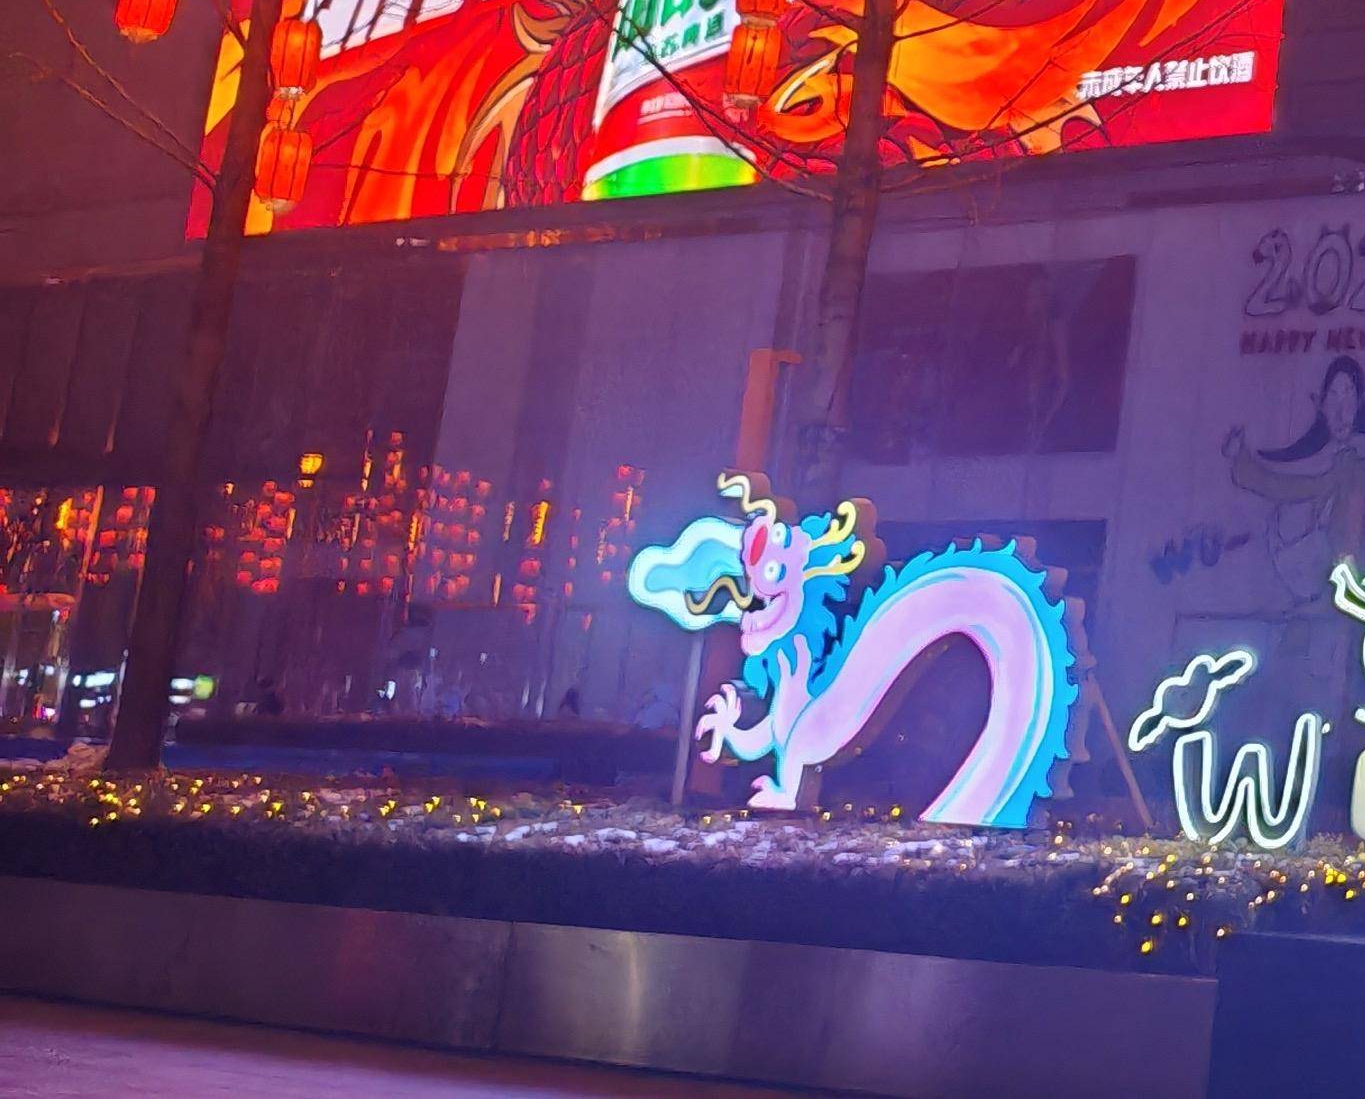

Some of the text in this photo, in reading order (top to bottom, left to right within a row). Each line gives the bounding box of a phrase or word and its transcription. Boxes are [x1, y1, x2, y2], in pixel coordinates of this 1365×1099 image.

[1076, 50, 1256, 102] 未成年人禁止饮酒
[1240, 329, 1318, 354] HAPPY
